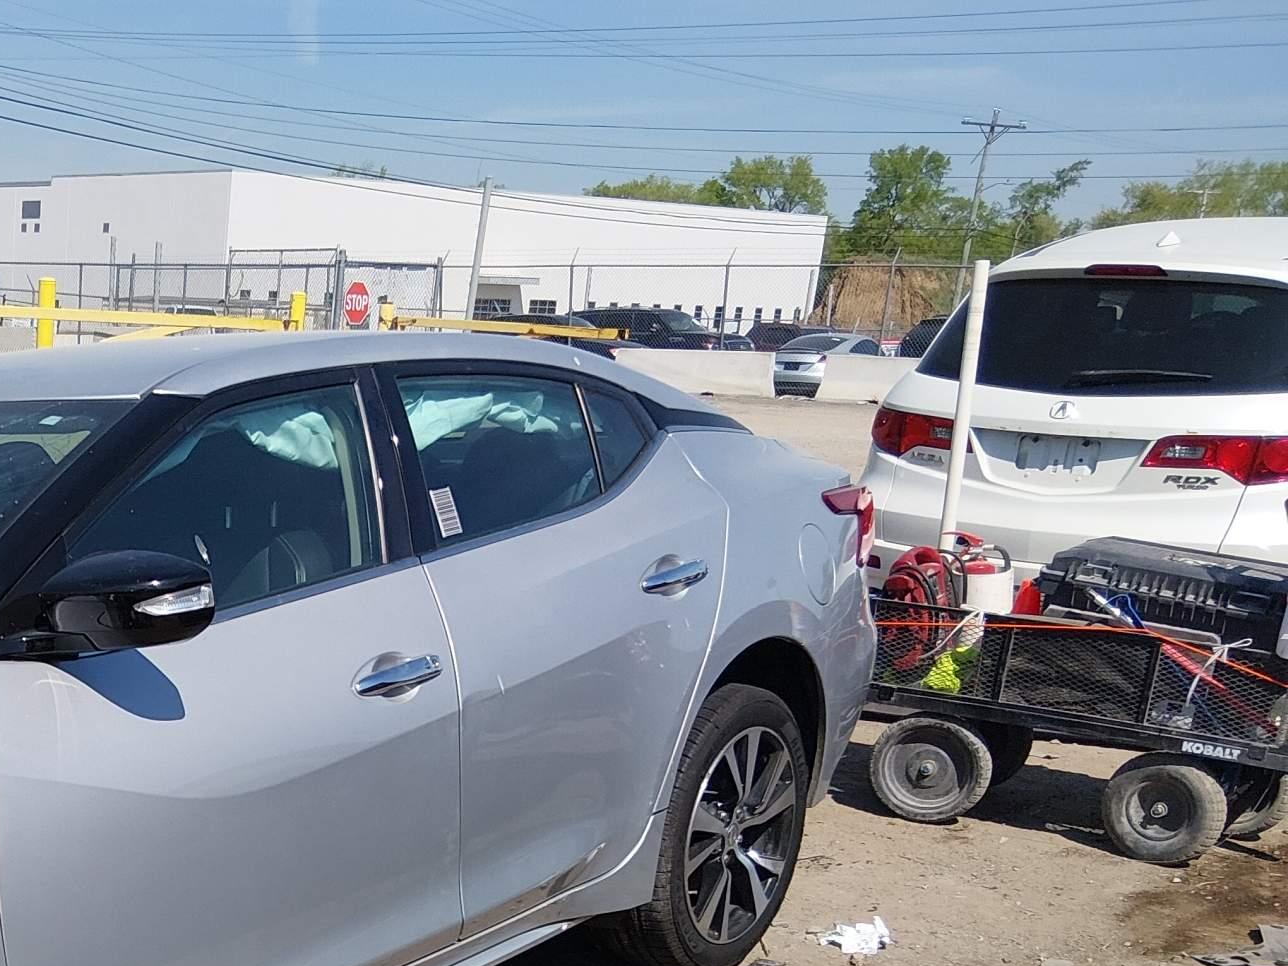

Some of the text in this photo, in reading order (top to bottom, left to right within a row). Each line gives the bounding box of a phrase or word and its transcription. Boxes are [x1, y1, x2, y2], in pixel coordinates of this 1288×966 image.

[346, 294, 368, 311] STOP
[1163, 474, 1220, 486] RDX
[1181, 741, 1241, 760] KOBALT
